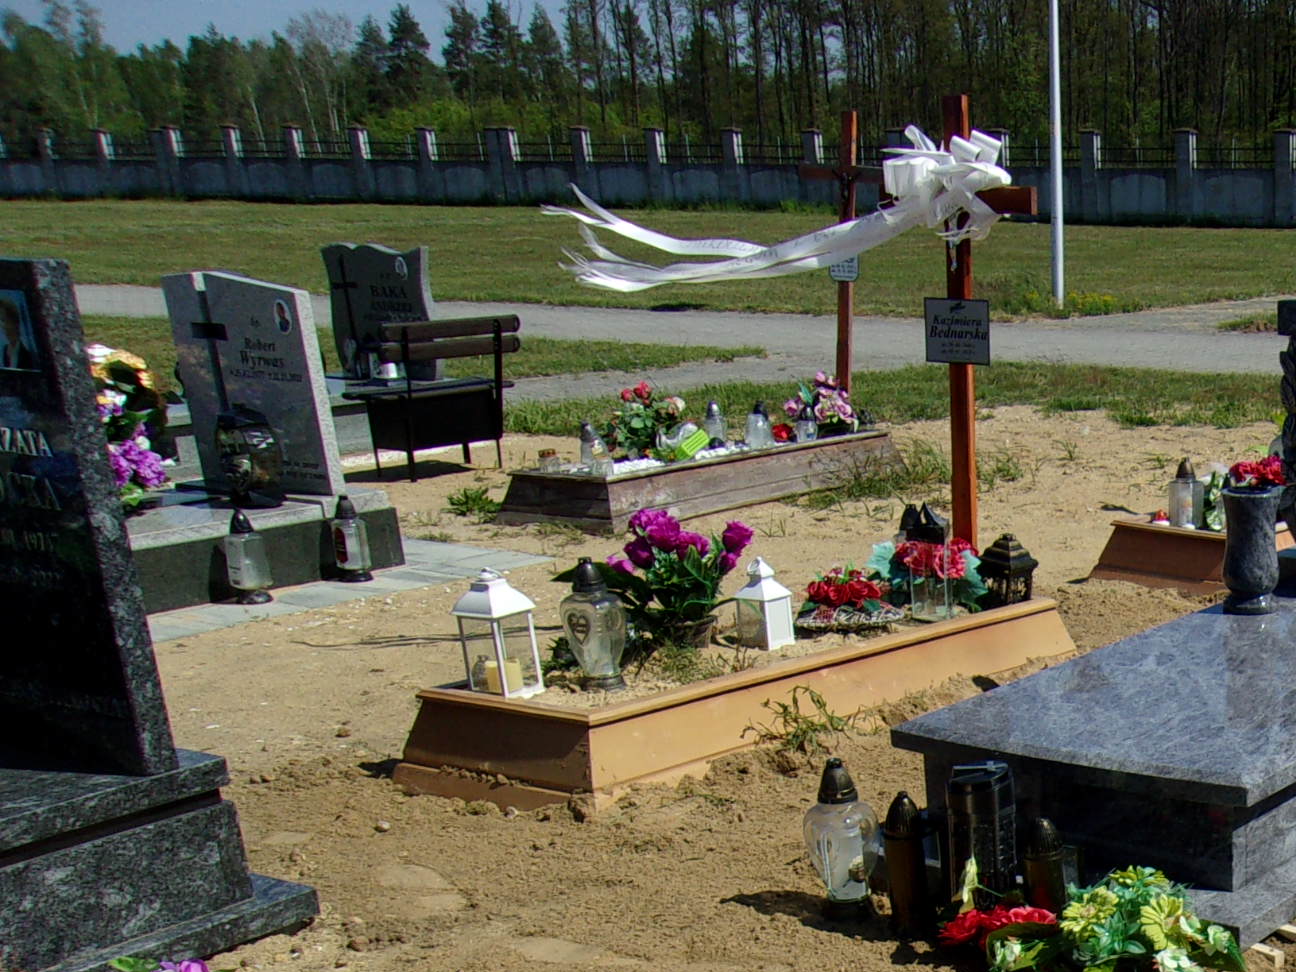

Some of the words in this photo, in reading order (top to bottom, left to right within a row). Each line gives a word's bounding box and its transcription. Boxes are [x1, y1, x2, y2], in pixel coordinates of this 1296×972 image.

[933, 315, 983, 326] Kazimiera
[929, 326, 988, 340] Bednarska
[244, 336, 276, 353] Robert
[0, 427, 54, 457] ZATA
